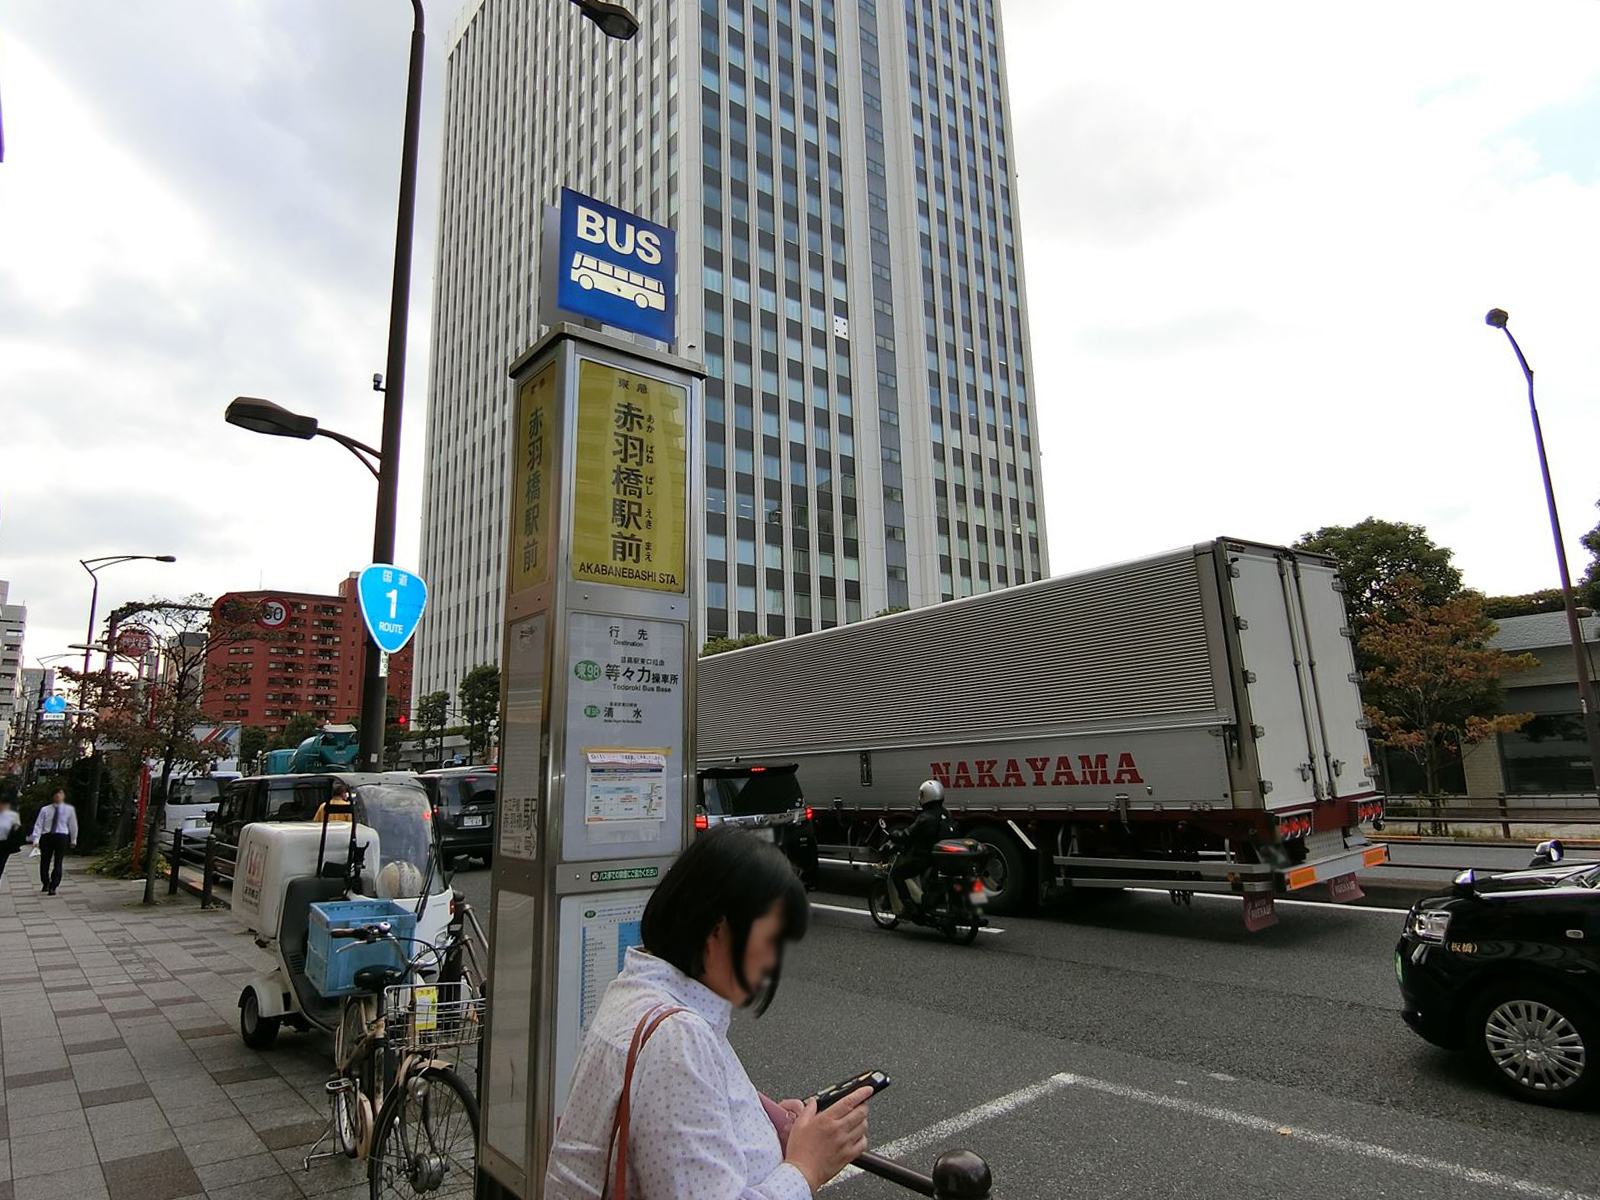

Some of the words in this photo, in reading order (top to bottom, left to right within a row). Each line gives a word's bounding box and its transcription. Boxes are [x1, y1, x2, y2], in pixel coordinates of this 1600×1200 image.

[577, 205, 662, 265] BUS
[618, 377, 648, 394] 東急
[523, 405, 543, 573] 赤羽橋駅前
[611, 402, 644, 563] 赤羽橋駅前
[579, 561, 656, 582] AKABANEBASHI
[658, 573, 679, 586] STA.
[386, 588, 398, 619] 1
[379, 622, 403, 634] ROUTE
[613, 639, 643, 647] Destination
[577, 663, 600, 678] 東98
[605, 664, 679, 685] 等々力操車所
[613, 684, 641, 692] Todoroki
[930, 752, 1144, 789] NAKAYAMA
